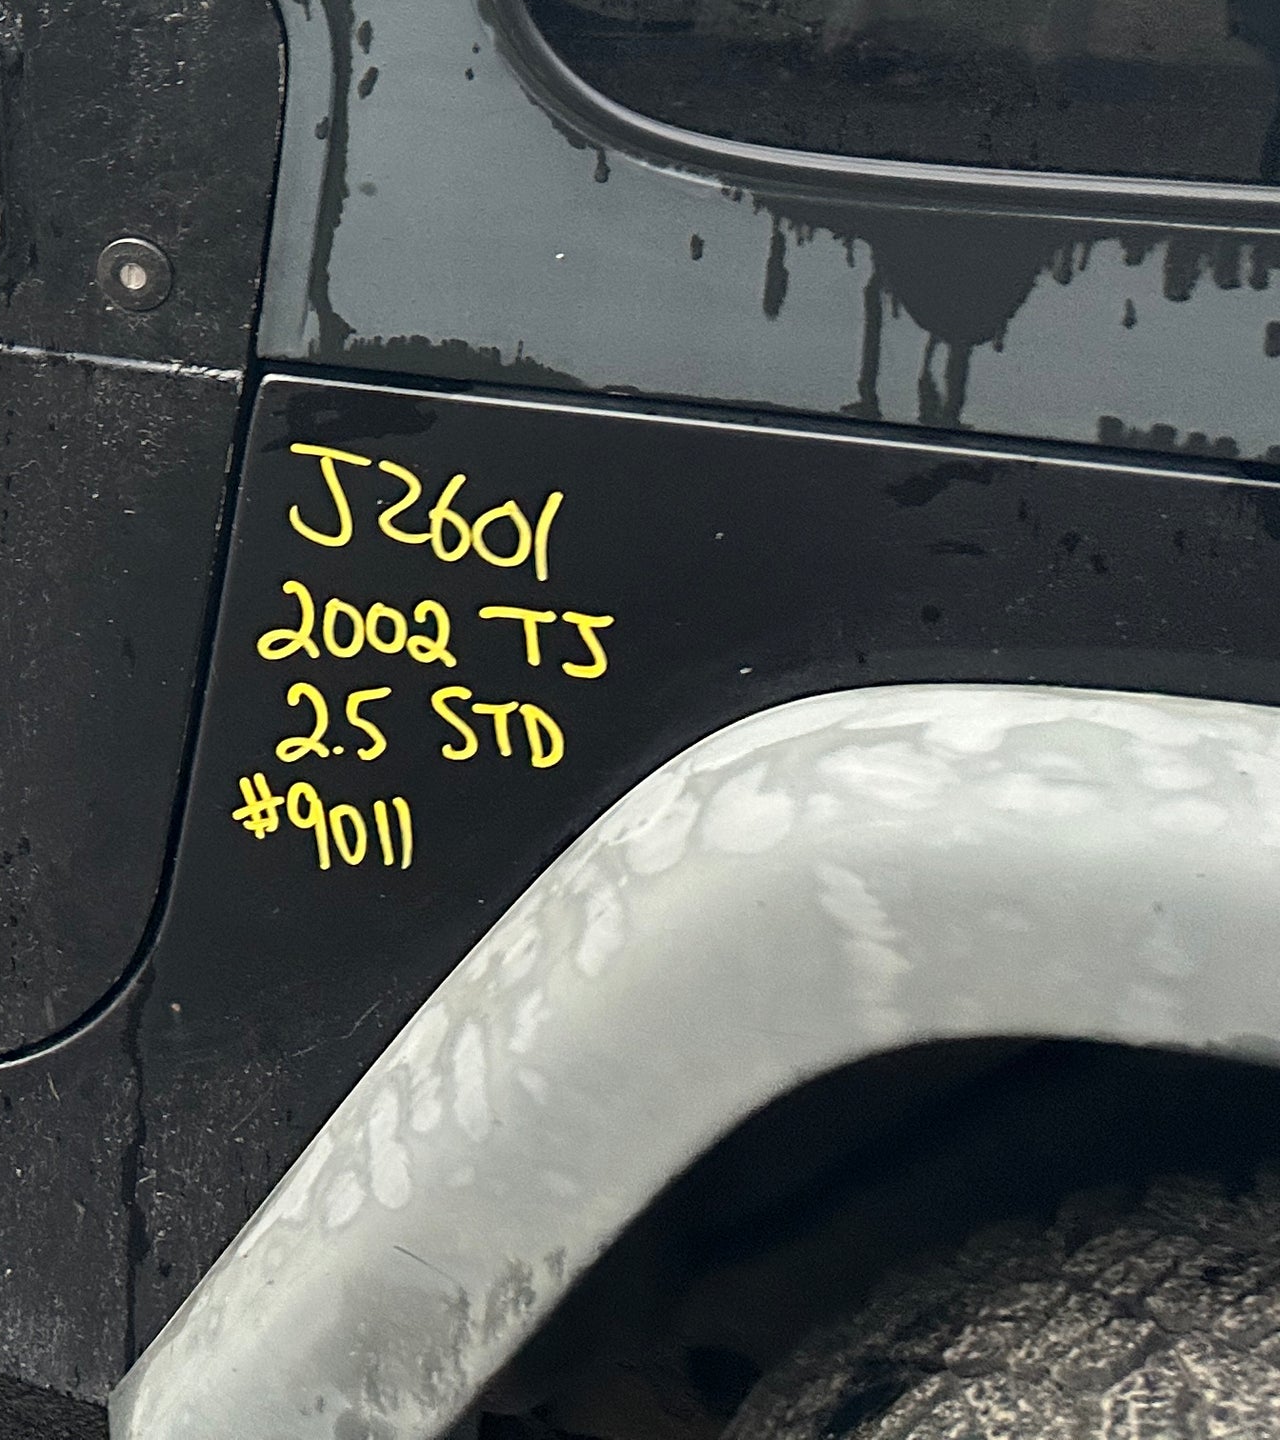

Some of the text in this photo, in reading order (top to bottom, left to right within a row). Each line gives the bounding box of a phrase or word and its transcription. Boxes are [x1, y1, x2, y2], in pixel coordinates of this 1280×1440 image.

[289, 442, 565, 582] J2601
[256, 580, 615, 679] 2002 TJ
[275, 682, 565, 769] 2.5 STD
[231, 772, 414, 870] #9011
